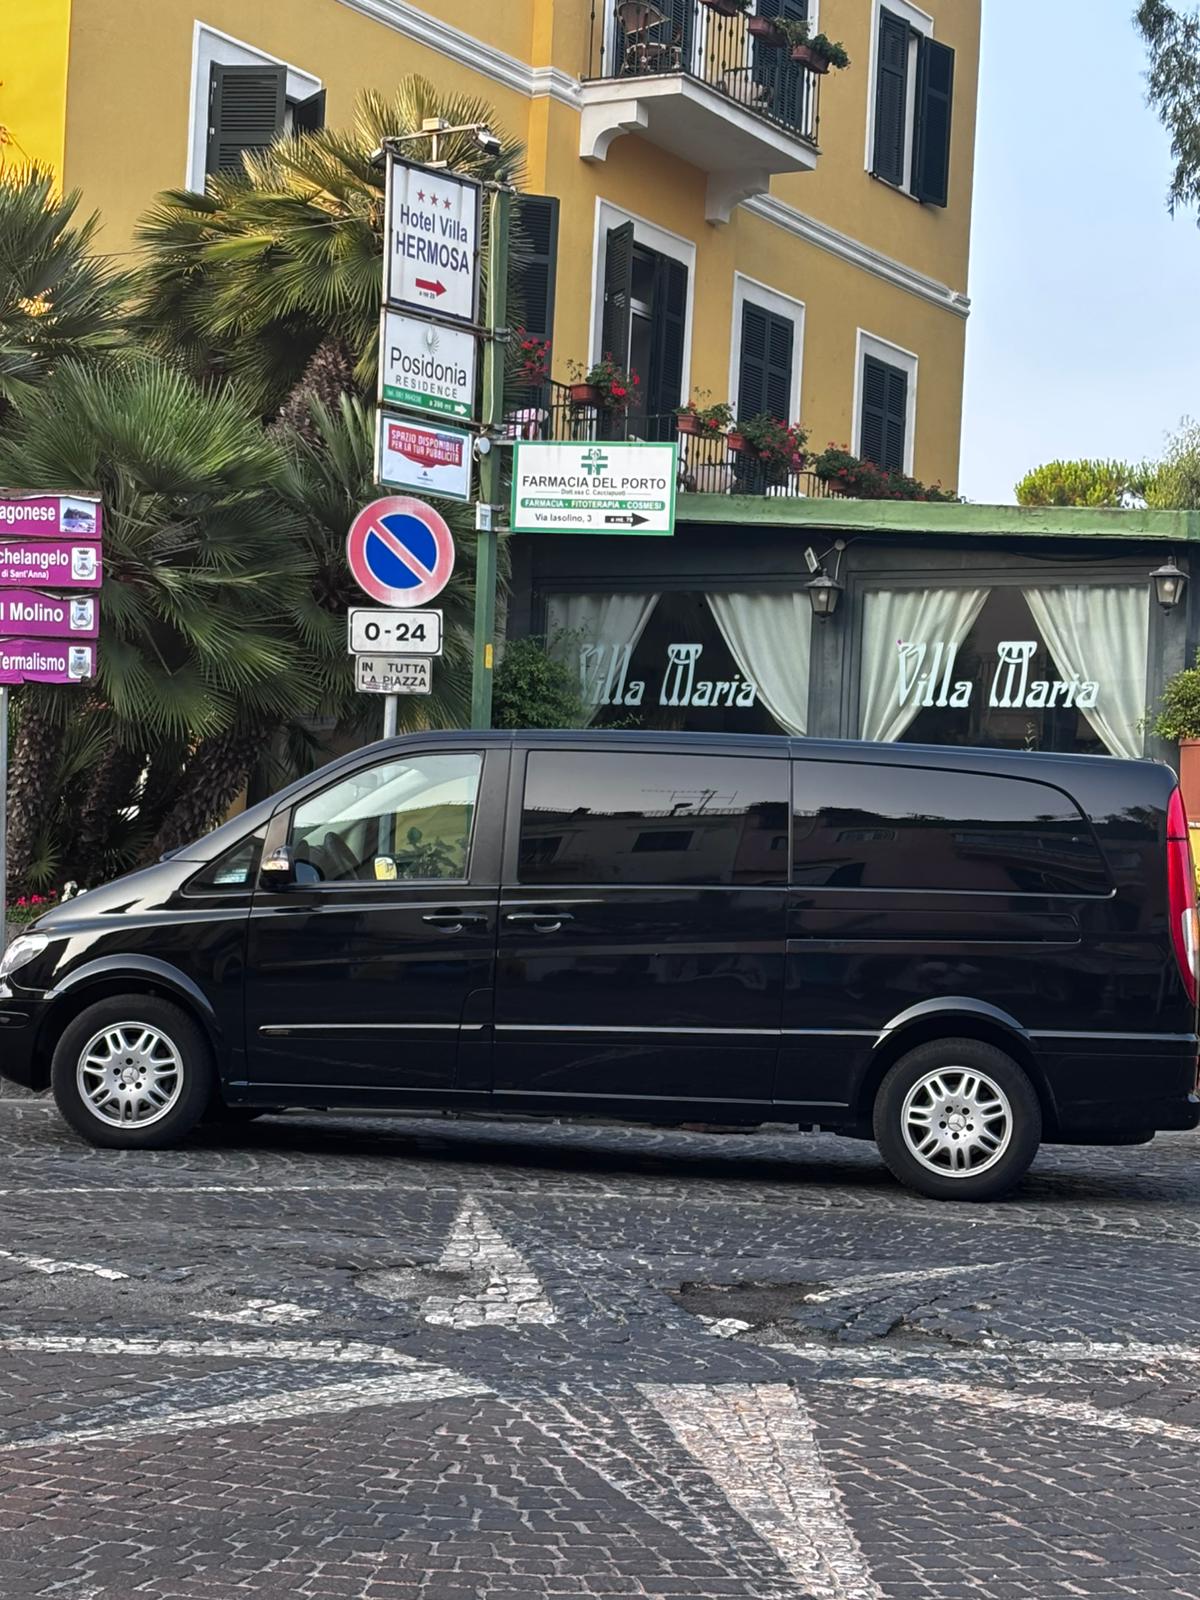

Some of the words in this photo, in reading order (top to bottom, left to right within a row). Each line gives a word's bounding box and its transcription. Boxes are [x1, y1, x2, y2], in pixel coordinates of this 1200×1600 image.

[400, 203, 436, 234] Hotel
[439, 215, 468, 244] Villa
[395, 230, 470, 275] HERMOSA
[390, 345, 467, 388] Posidonia
[395, 374, 458, 399] RESIDENCE
[391, 429, 417, 444] SPAZIO
[418, 435, 459, 453] DISPONIBILE
[391, 439, 403, 449] PER
[404, 442, 412, 452] LA
[413, 444, 425, 455] TUA
[522, 475, 589, 488] FARMACIA
[592, 477, 618, 489] DEL
[621, 477, 666, 490] PORTO
[524, 498, 564, 508] FARMACIA
[571, 499, 620, 509] FITOTERAPIA
[626, 501, 662, 510] COSMESI
[535, 513, 548, 522] Via
[586, 514, 592, 522] 3
[1, 569, 9, 578] di
[10, 569, 50, 581] Sant'Anna)
[10, 602, 64, 622] Molino
[362, 661, 374, 672] IN
[387, 662, 427, 674] TUTTA
[579, 643, 646, 706] Villa
[659, 643, 758, 707] Maria
[897, 641, 973, 708] Villa
[988, 641, 1100, 708] Maria
[361, 674, 377, 685] LA
[382, 675, 427, 687] PIAZZA
